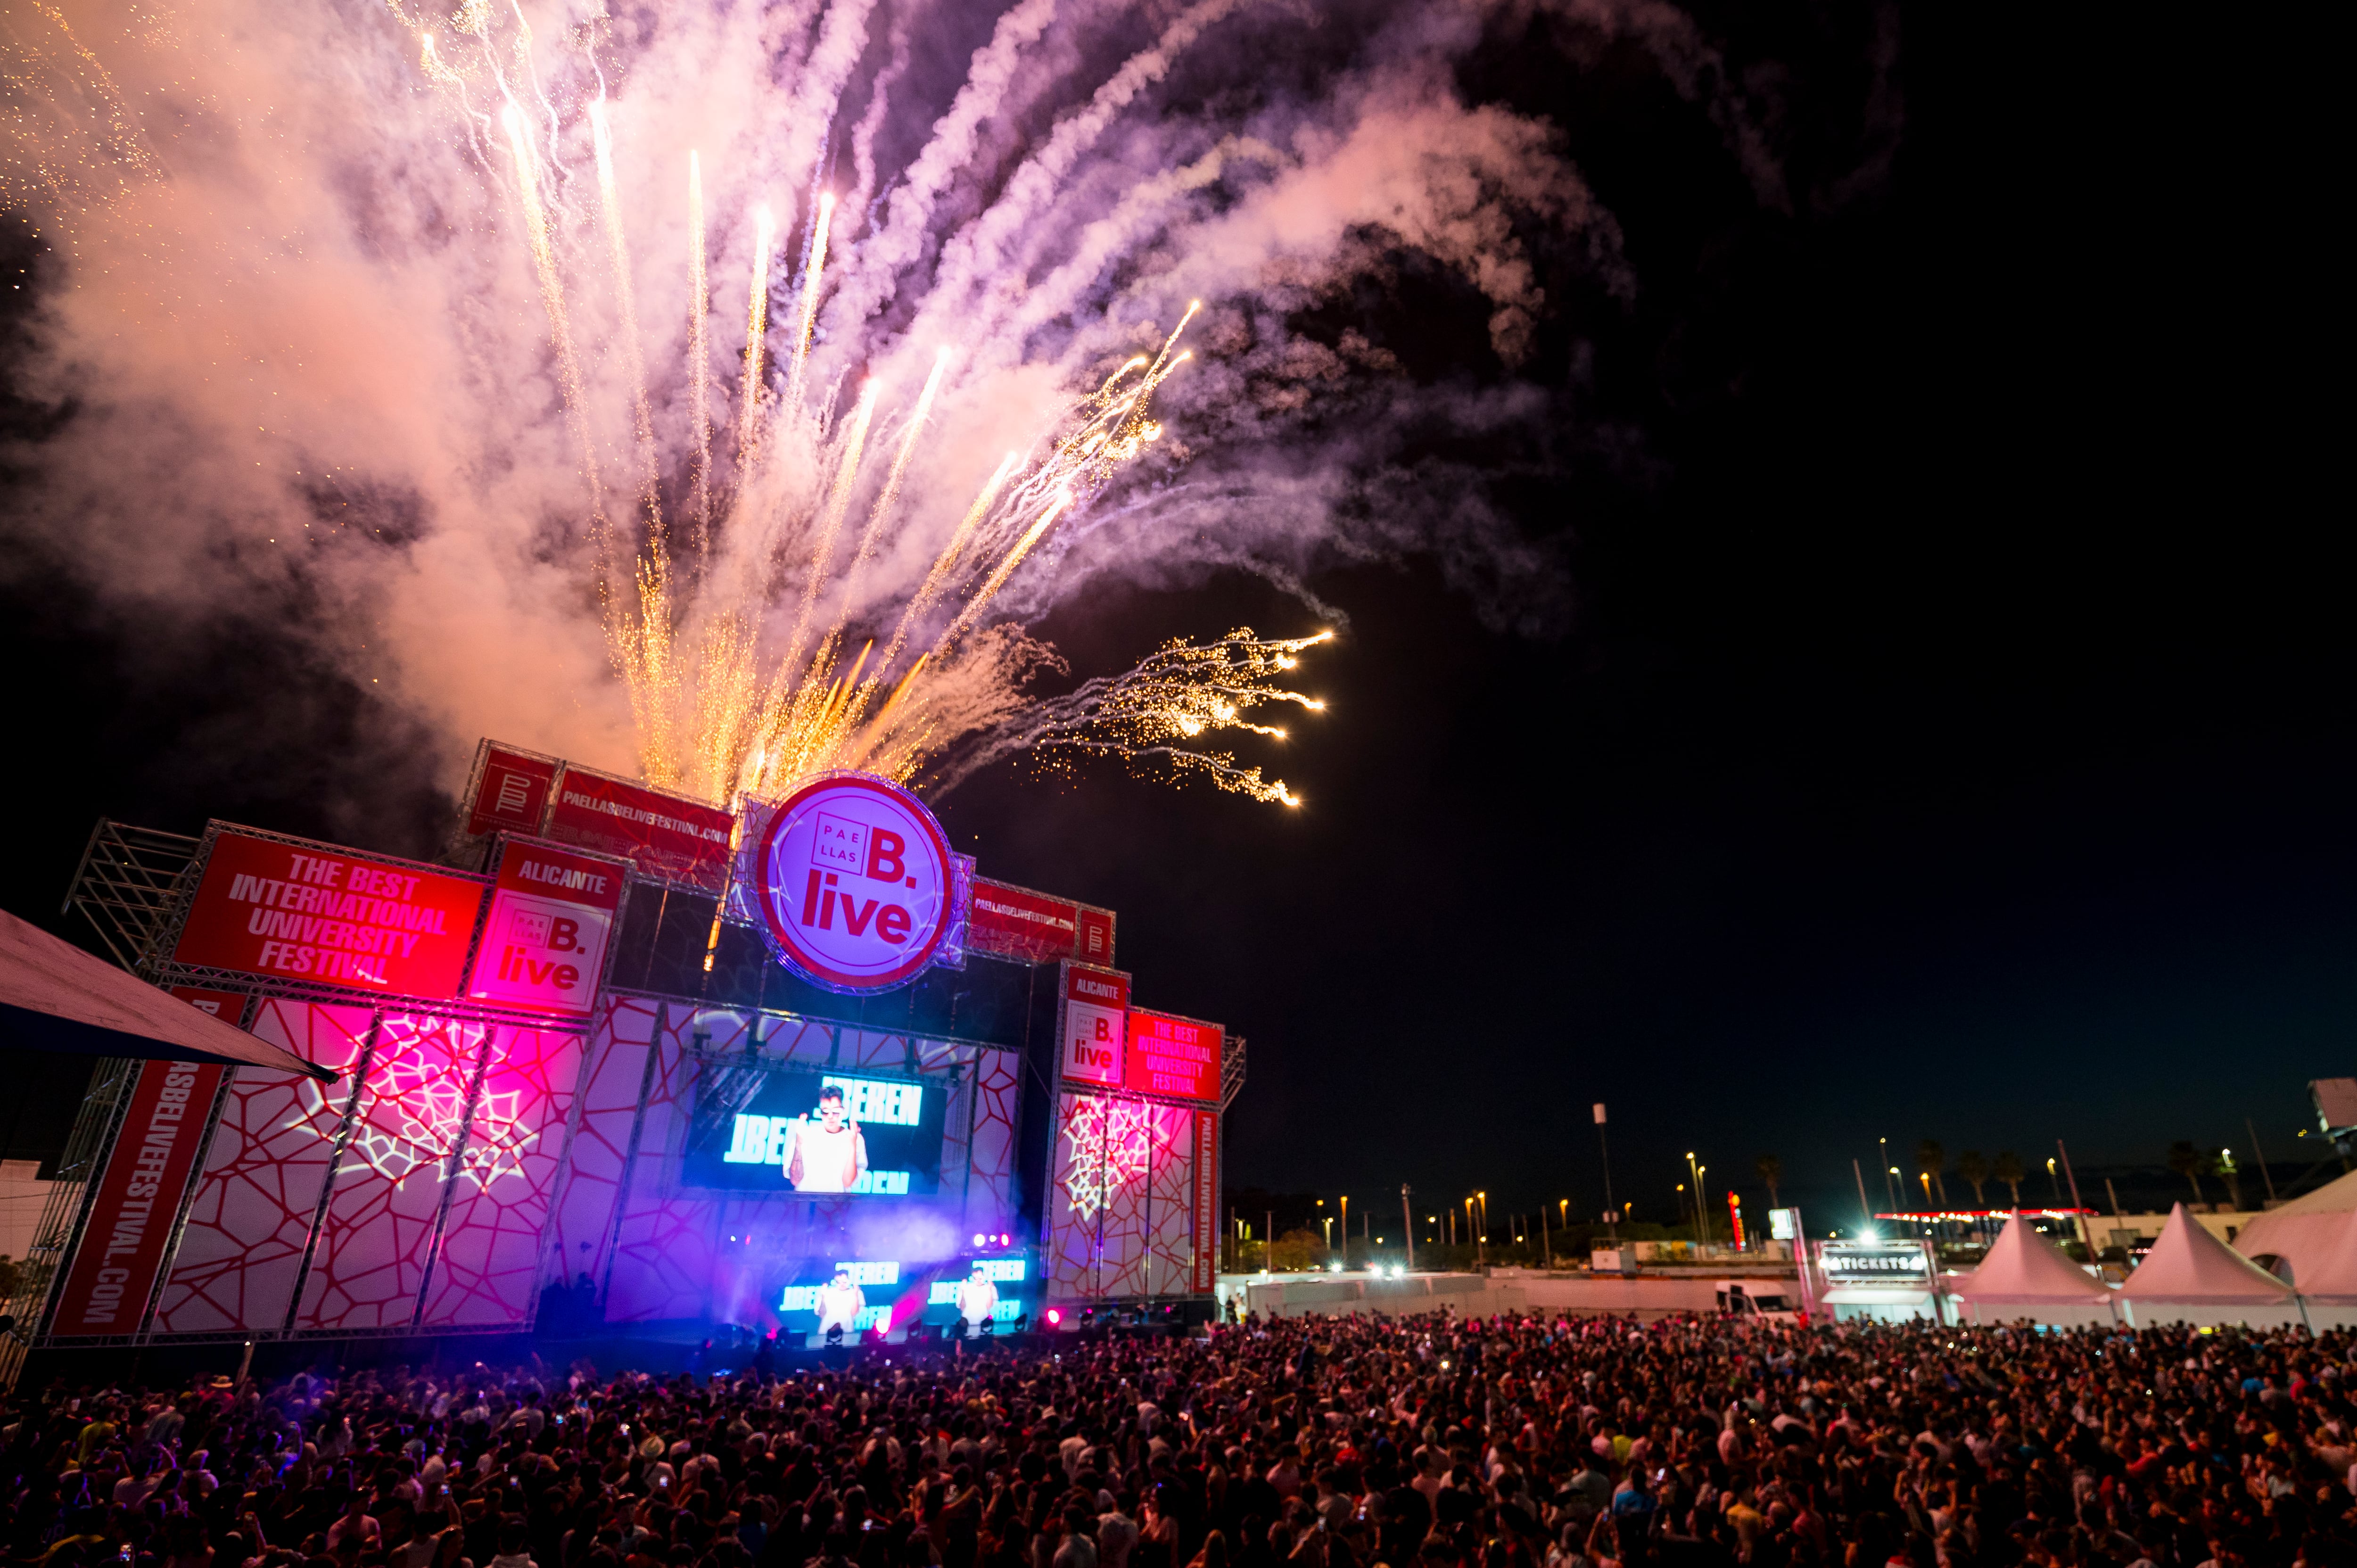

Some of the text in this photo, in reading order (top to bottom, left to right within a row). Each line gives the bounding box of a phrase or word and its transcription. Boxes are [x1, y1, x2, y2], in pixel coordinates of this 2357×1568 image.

[563, 791, 728, 844] PAELLASBELIVEFESTIVAL.COM
[824, 825, 859, 843] PAE
[821, 845, 856, 863] LLAS
[289, 854, 420, 900] THE BEST
[519, 860, 607, 894] ALICANTE
[229, 874, 446, 935] INTERNATIONAL
[801, 868, 912, 945] live
[975, 898, 1074, 931] PAELLASBELIVEFESTIVAL.COM
[248, 908, 420, 958] UNIVERSITY
[518, 917, 544, 928] PAE
[258, 941, 387, 984] FESTIVAL
[498, 945, 579, 990] live
[1076, 978, 1119, 999] ALICANTE
[1154, 1021, 1198, 1043] THE BEST
[1074, 1039, 1113, 1069] live
[1137, 1035, 1211, 1063] INTERNATIONAL
[1146, 1054, 1203, 1078] UNIVERSITY
[1153, 1073, 1196, 1094] FESTIVAL
[83, 999, 220, 1323] PASBELIVEFESTIVAL.COM
[1840, 1257, 1909, 1270] TICKETS
